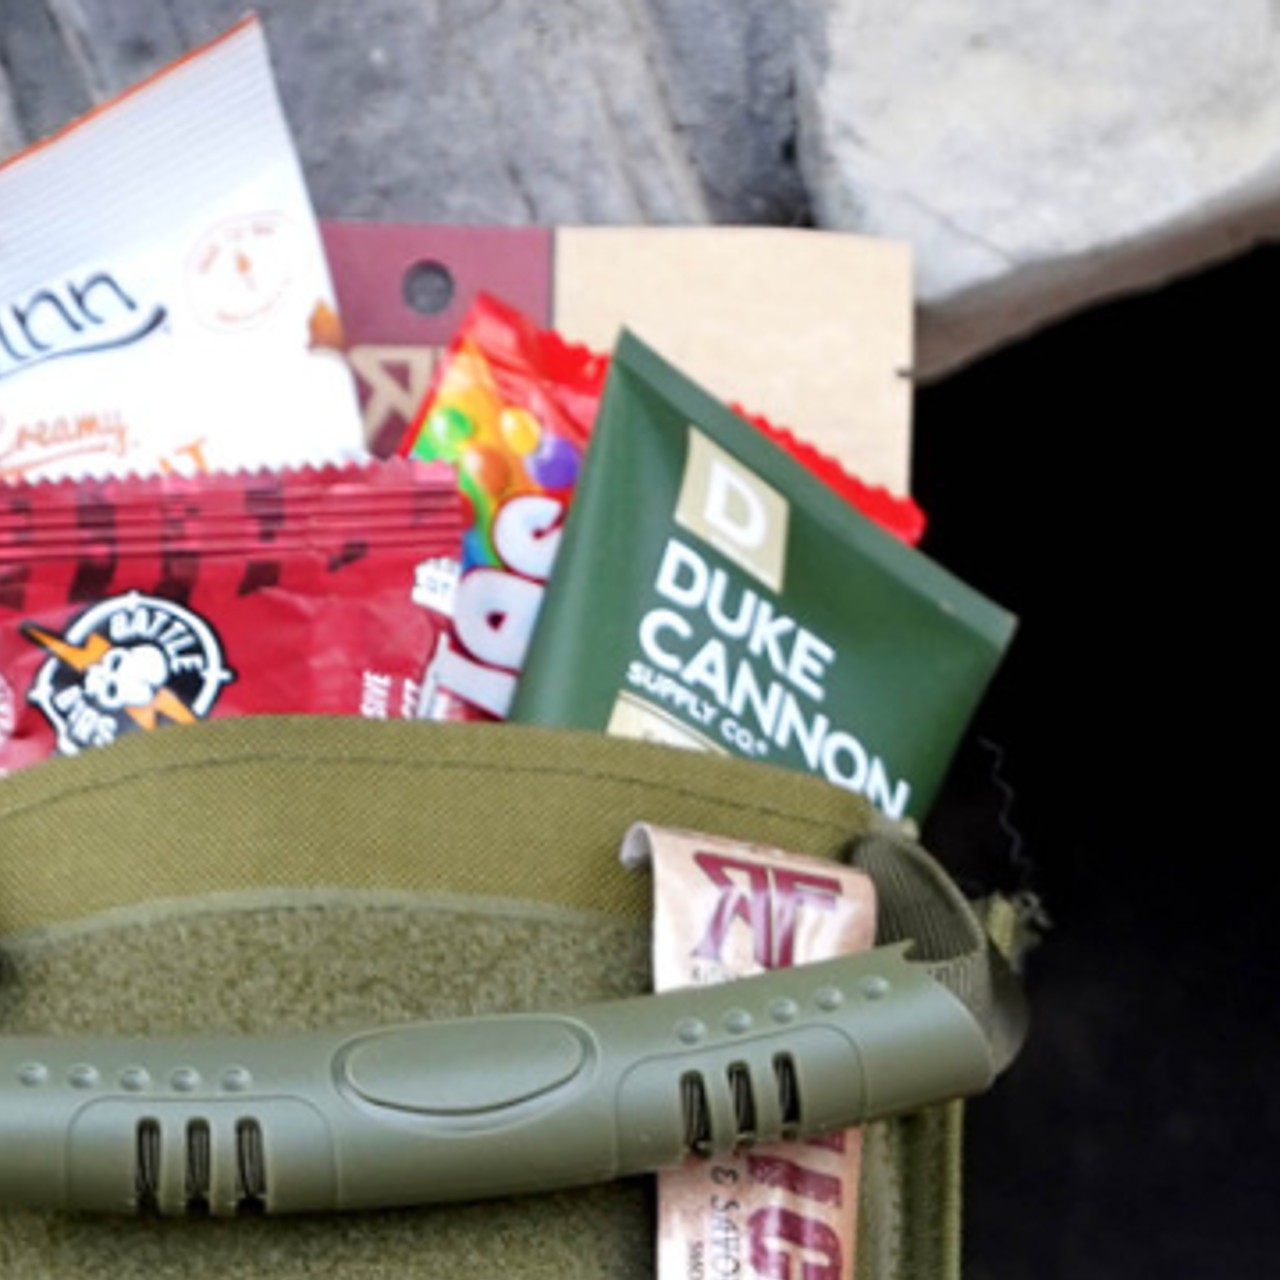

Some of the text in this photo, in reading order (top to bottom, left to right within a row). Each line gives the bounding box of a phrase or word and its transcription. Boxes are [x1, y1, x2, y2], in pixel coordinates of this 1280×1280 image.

[701, 456, 770, 550] D
[108, 606, 204, 675] BATTLE
[655, 538, 836, 700] DUKE
[625, 660, 718, 727] SUPPLY
[638, 610, 911, 822] CANNON
